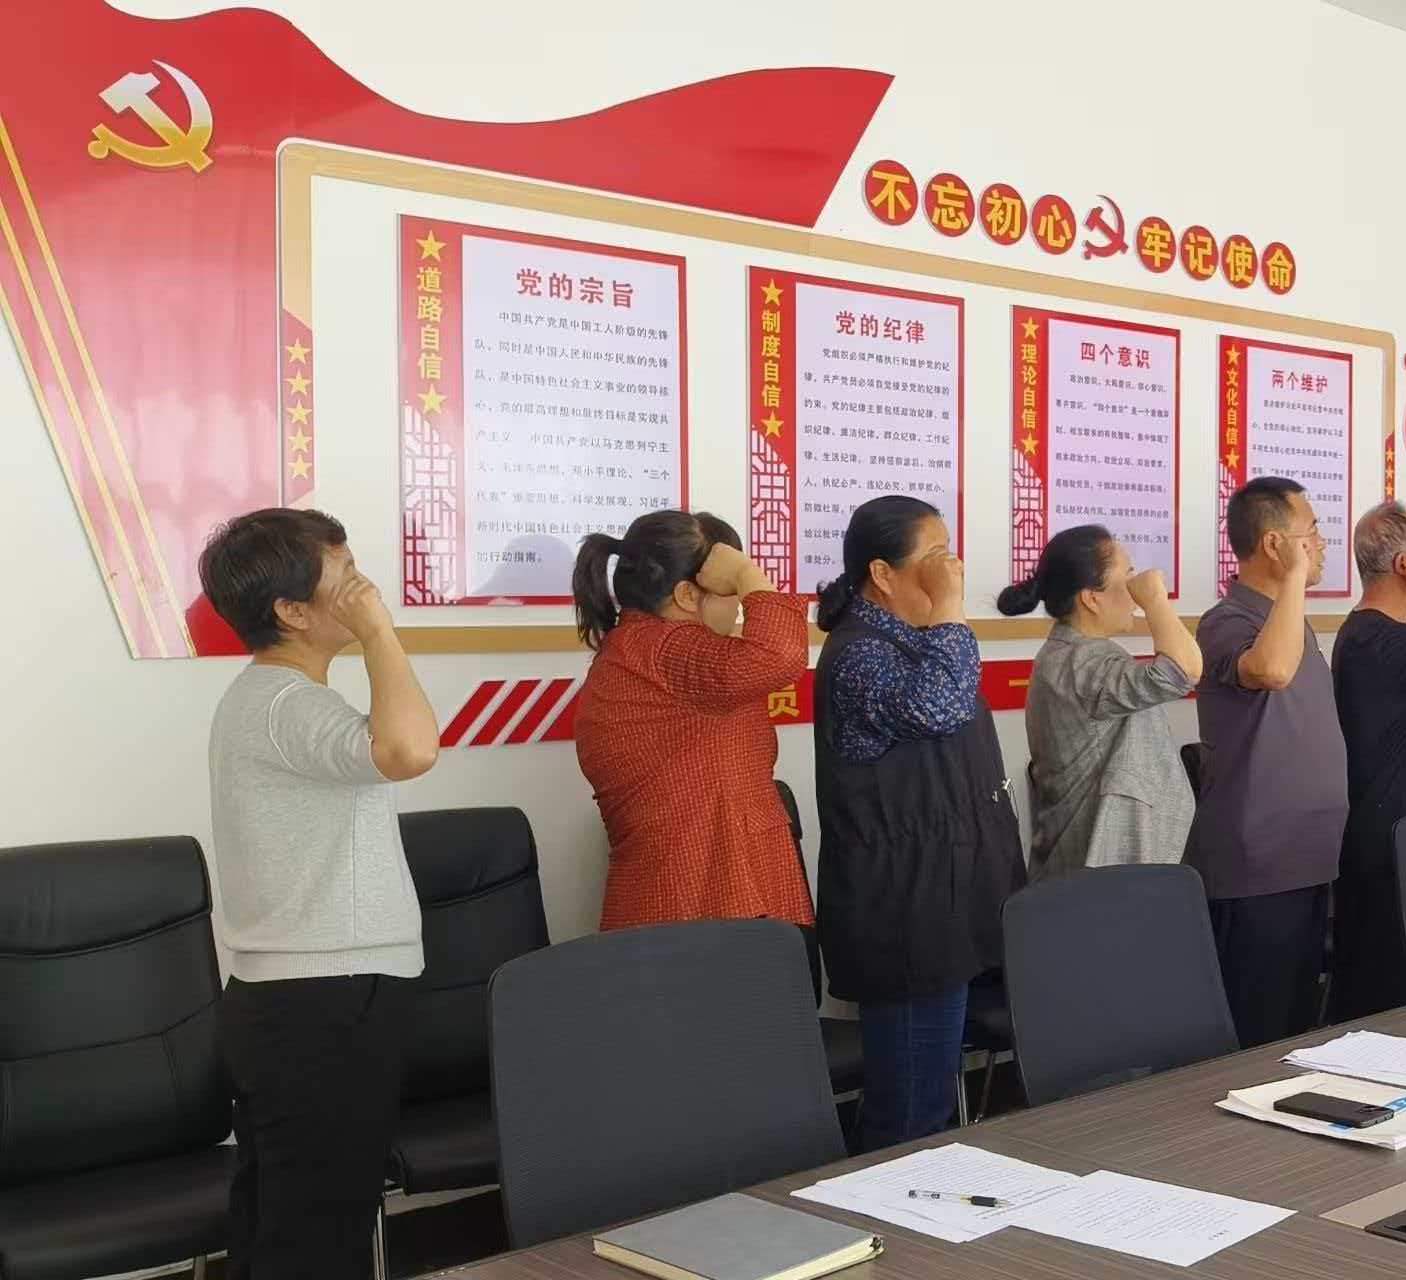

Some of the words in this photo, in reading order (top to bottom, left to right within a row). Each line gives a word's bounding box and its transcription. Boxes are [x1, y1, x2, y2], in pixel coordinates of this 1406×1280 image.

[870, 170, 1072, 248] 不忘初心
[1141, 222, 1294, 289] 牢记使命
[416, 267, 443, 380] 道路自信
[516, 268, 634, 308] 党的宗旨
[761, 311, 781, 408] 制度自信
[835, 310, 926, 344] 党的纪律
[1081, 342, 1151, 369] 四个意识
[1021, 343, 1037, 429] 理论自信
[1225, 368, 1238, 445] 文化自信
[1271, 369, 1328, 393] 两个维护
